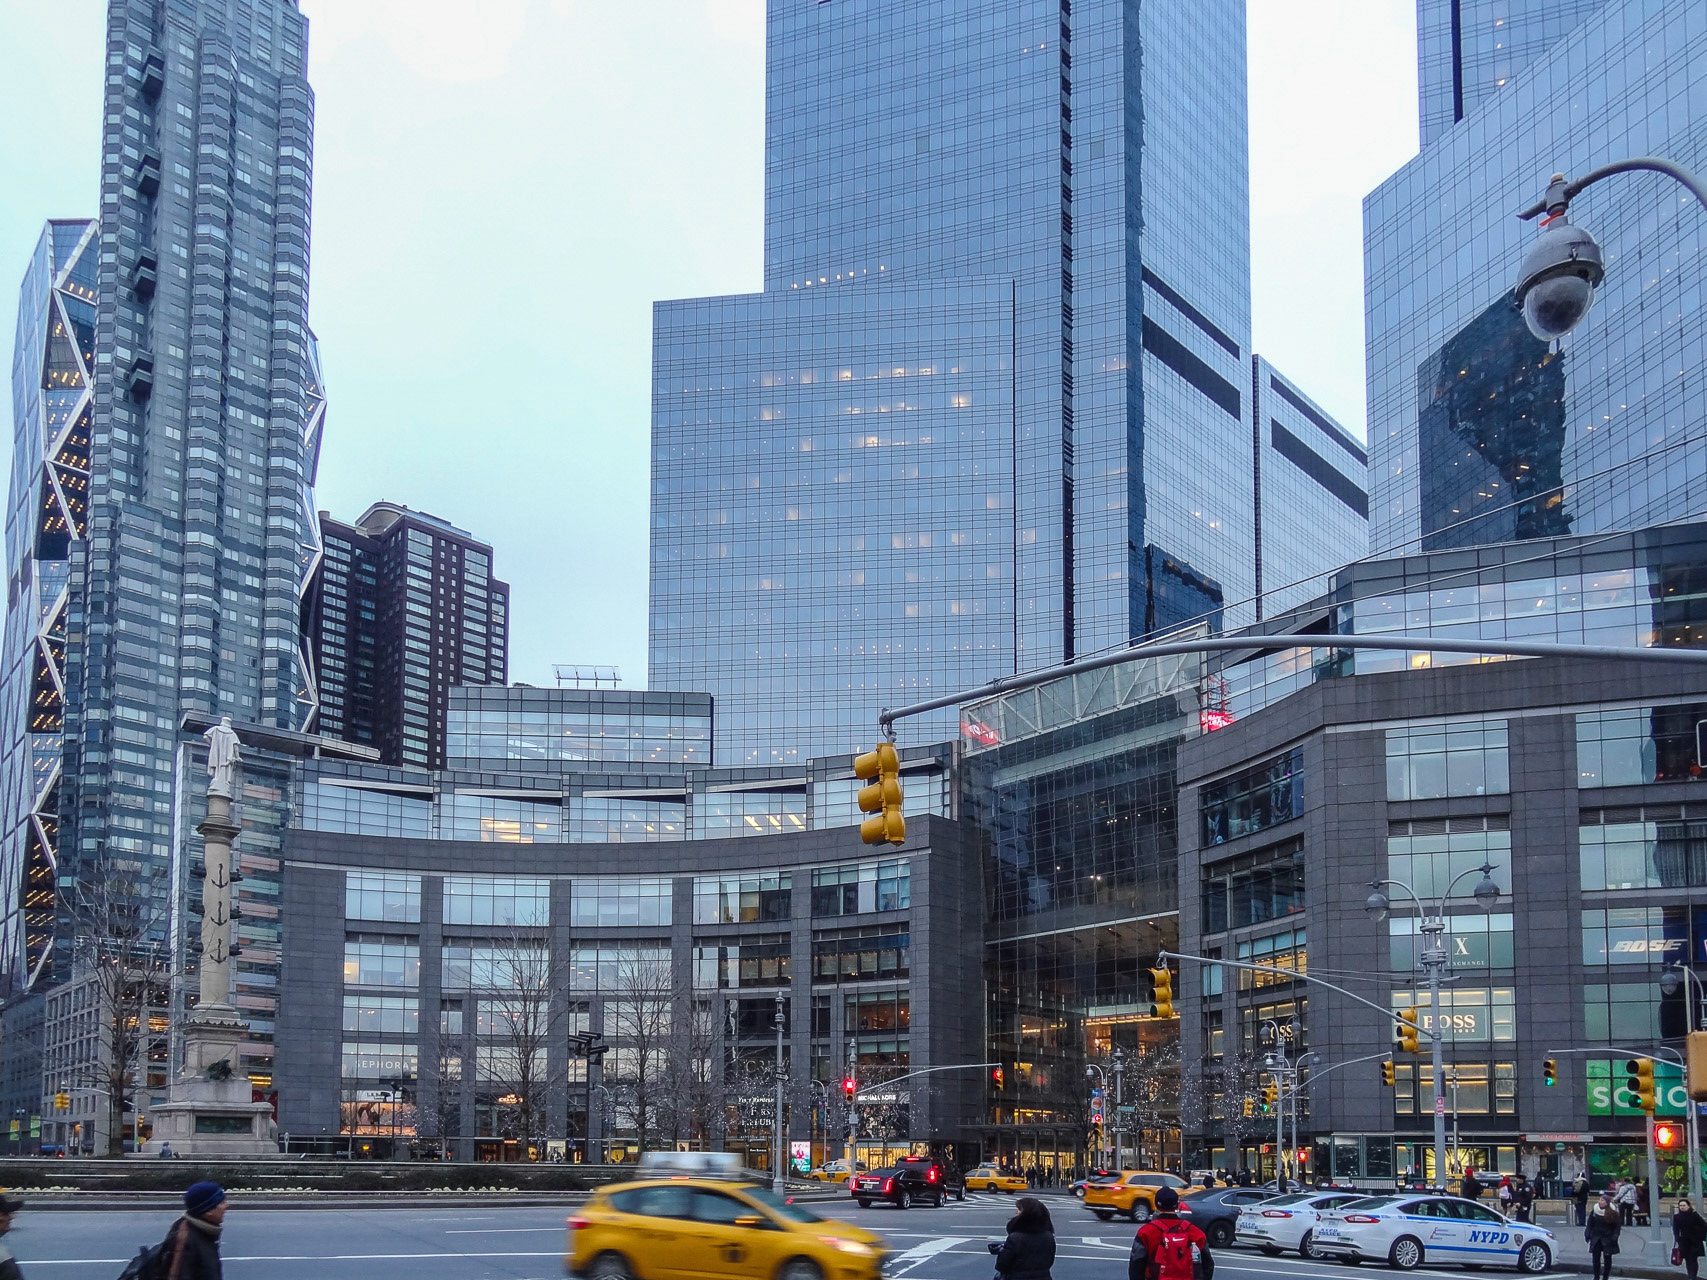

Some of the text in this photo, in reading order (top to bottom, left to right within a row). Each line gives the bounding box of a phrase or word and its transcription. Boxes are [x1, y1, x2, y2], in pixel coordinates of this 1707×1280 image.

[1454, 937, 1470, 955] X
[1599, 939, 1688, 953] BOSE
[1468, 1230, 1510, 1245] NYPD
